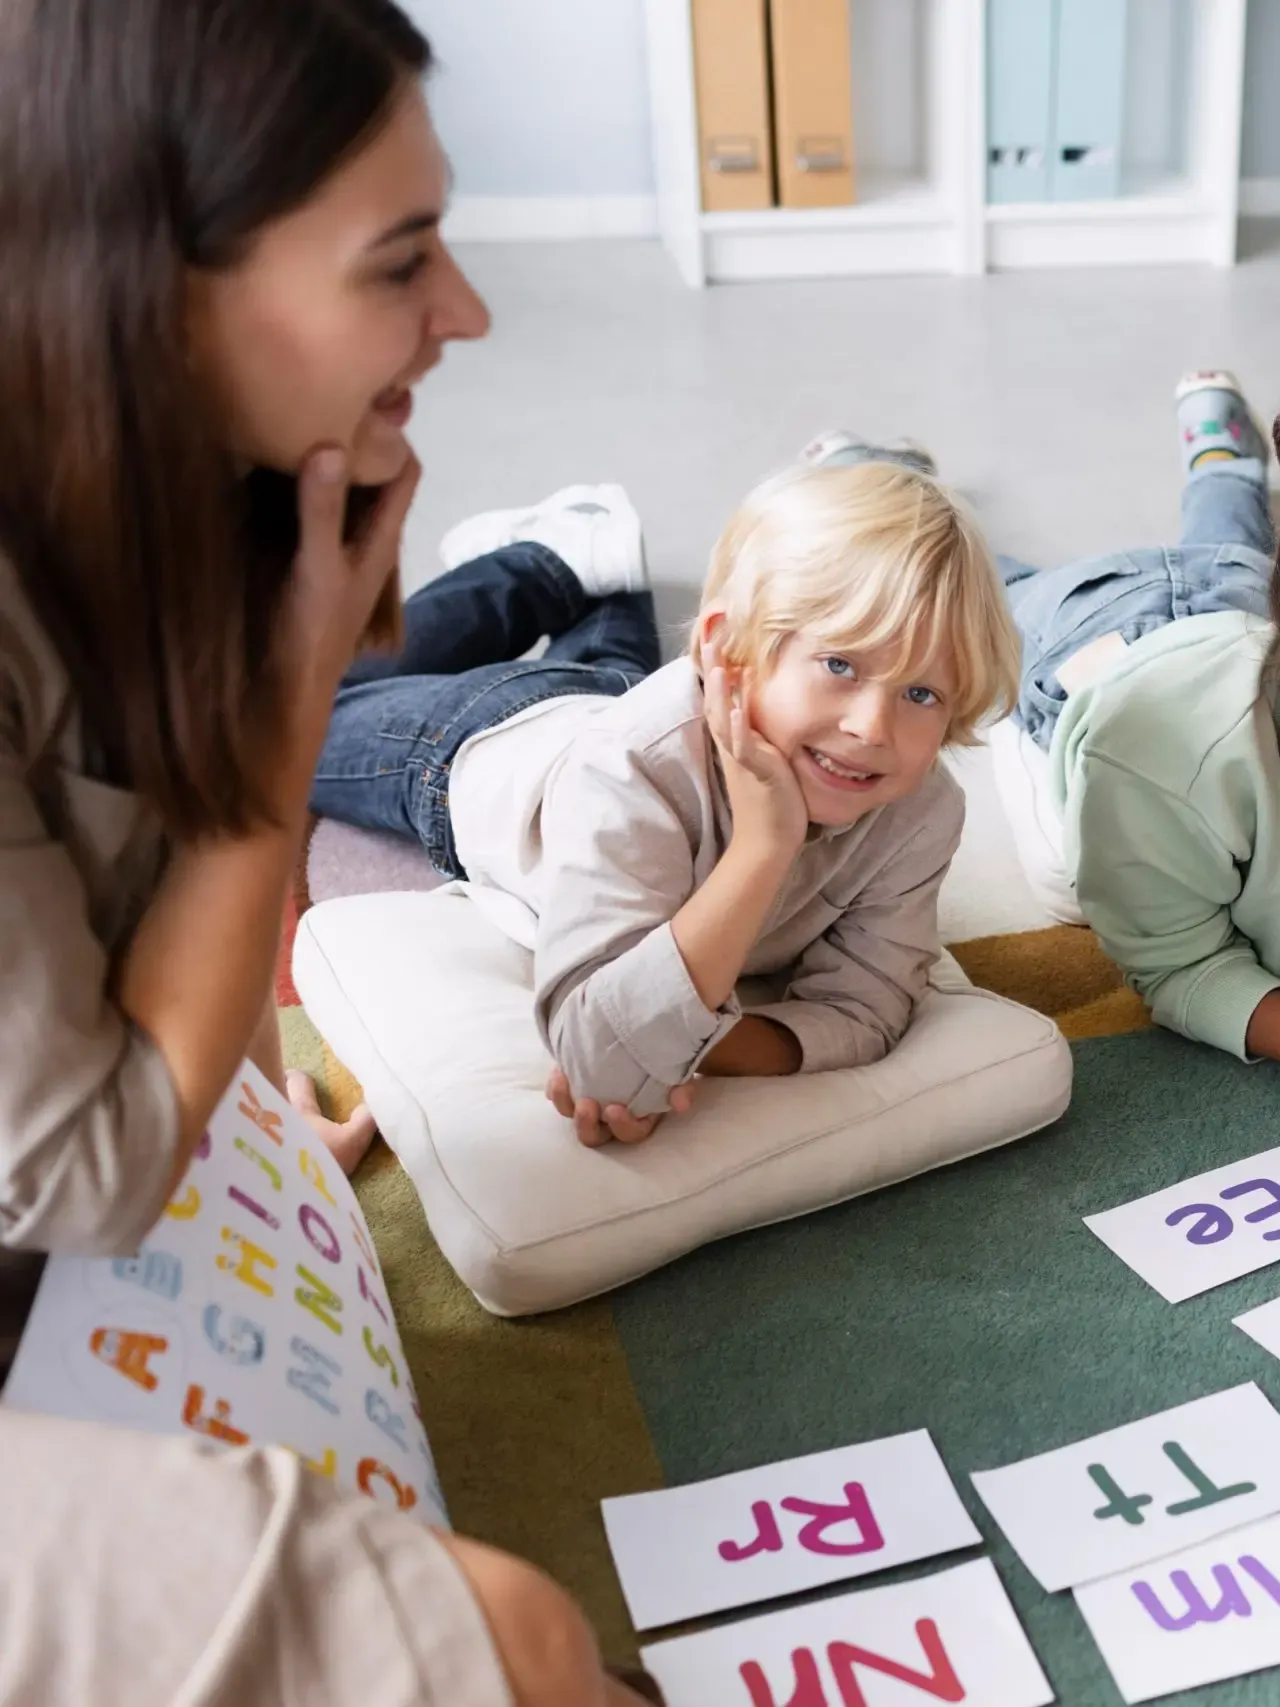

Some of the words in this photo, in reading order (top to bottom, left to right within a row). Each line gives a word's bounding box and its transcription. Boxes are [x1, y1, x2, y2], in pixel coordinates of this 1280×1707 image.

[238, 1081, 284, 1147] K
[233, 1136, 282, 1192] J
[215, 1225, 278, 1297] H
[298, 1204, 342, 1265] O
[294, 1262, 343, 1336] N
[90, 1326, 168, 1393] A
[203, 1302, 266, 1367] G
[362, 1325, 398, 1388] S
[285, 1334, 343, 1418] M
[182, 1382, 250, 1447] F
[364, 1387, 410, 1454] R
[1087, 1441, 1257, 1525] Tt
[718, 1481, 885, 1562] Rr
[739, 1617, 966, 1707] Nn
